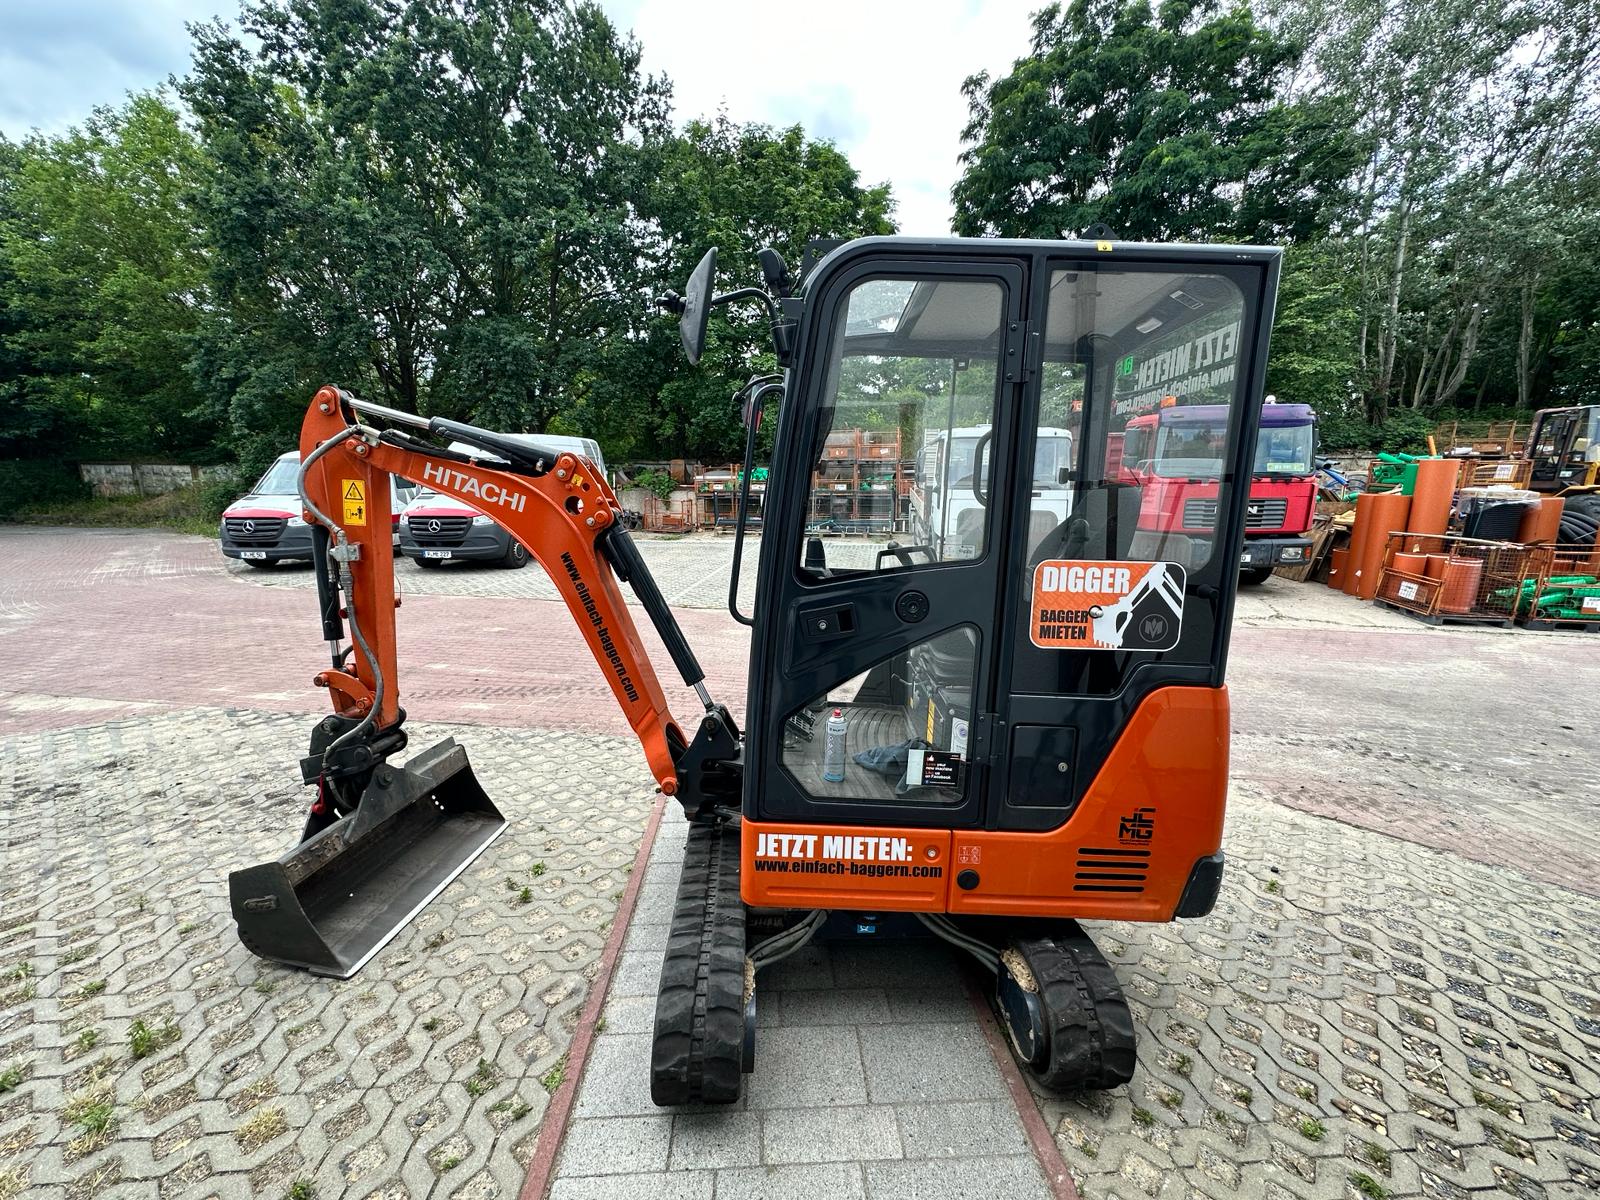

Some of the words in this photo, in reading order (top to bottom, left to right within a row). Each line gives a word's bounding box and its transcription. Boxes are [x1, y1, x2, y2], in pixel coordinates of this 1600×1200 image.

[423, 461, 527, 513] HITACHI
[1041, 566, 1131, 594] DIGGER
[560, 551, 640, 703] www.einfach-baggern.com
[1040, 609, 1089, 624] BAGGER
[1039, 625, 1088, 640] MIETEN
[756, 833, 818, 858] JETZT
[823, 835, 913, 861] MIETEN:
[755, 860, 942, 878] www.einfach-baggern.com
